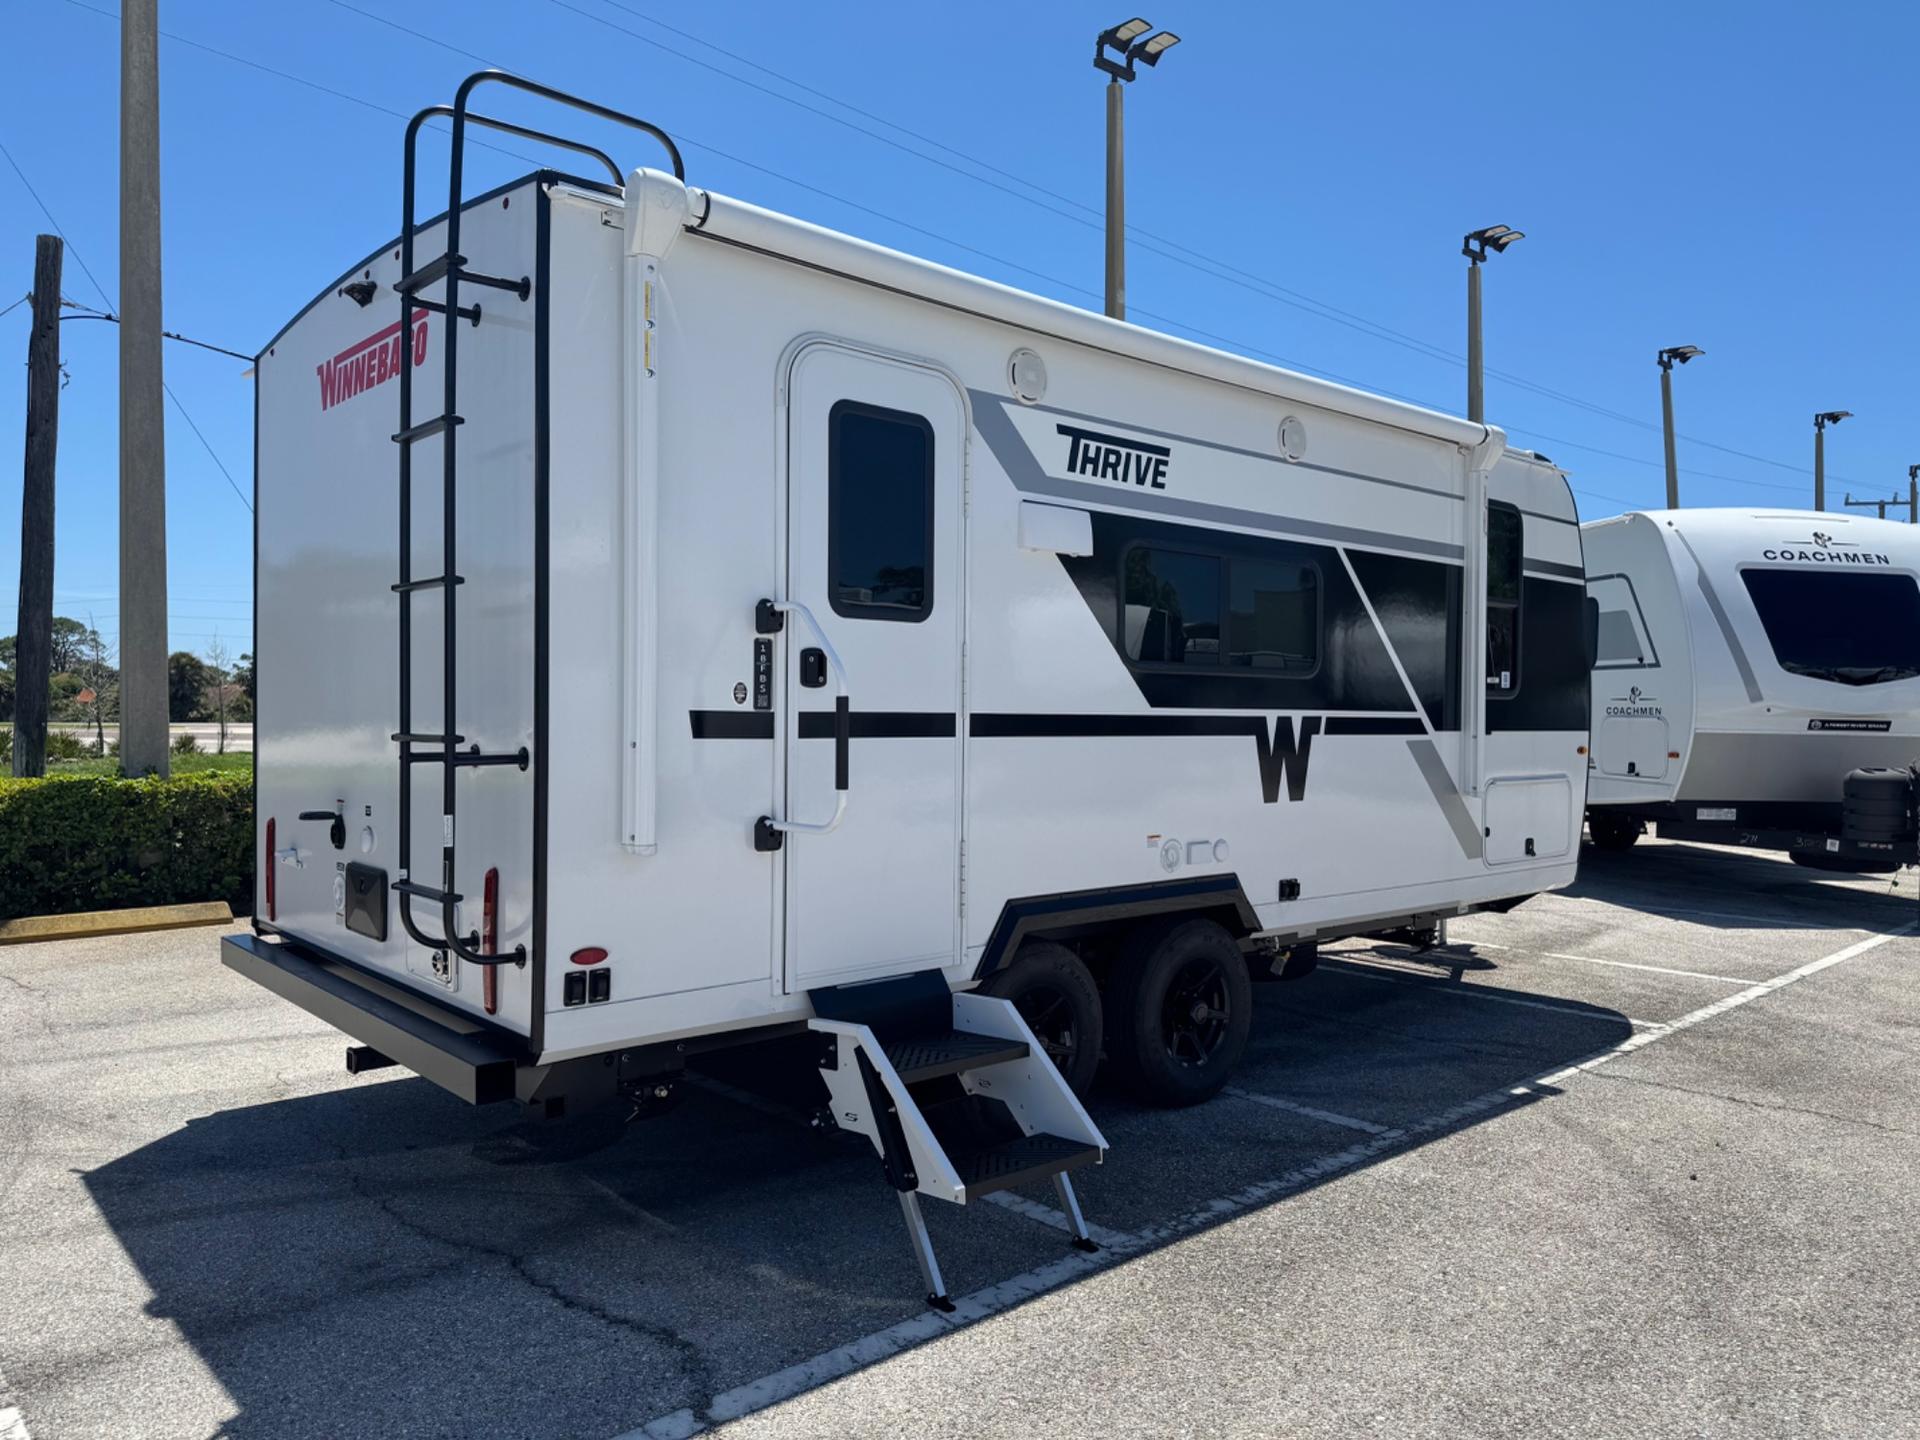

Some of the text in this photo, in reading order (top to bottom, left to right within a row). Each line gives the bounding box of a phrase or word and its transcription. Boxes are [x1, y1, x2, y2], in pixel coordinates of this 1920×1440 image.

[317, 308, 429, 412] WINNEBAO
[1056, 423, 1171, 489] THRIVE
[1763, 549, 1890, 565] COACHMEN
[1606, 706, 1662, 716] COACHMEN
[1255, 715, 1323, 804] W
